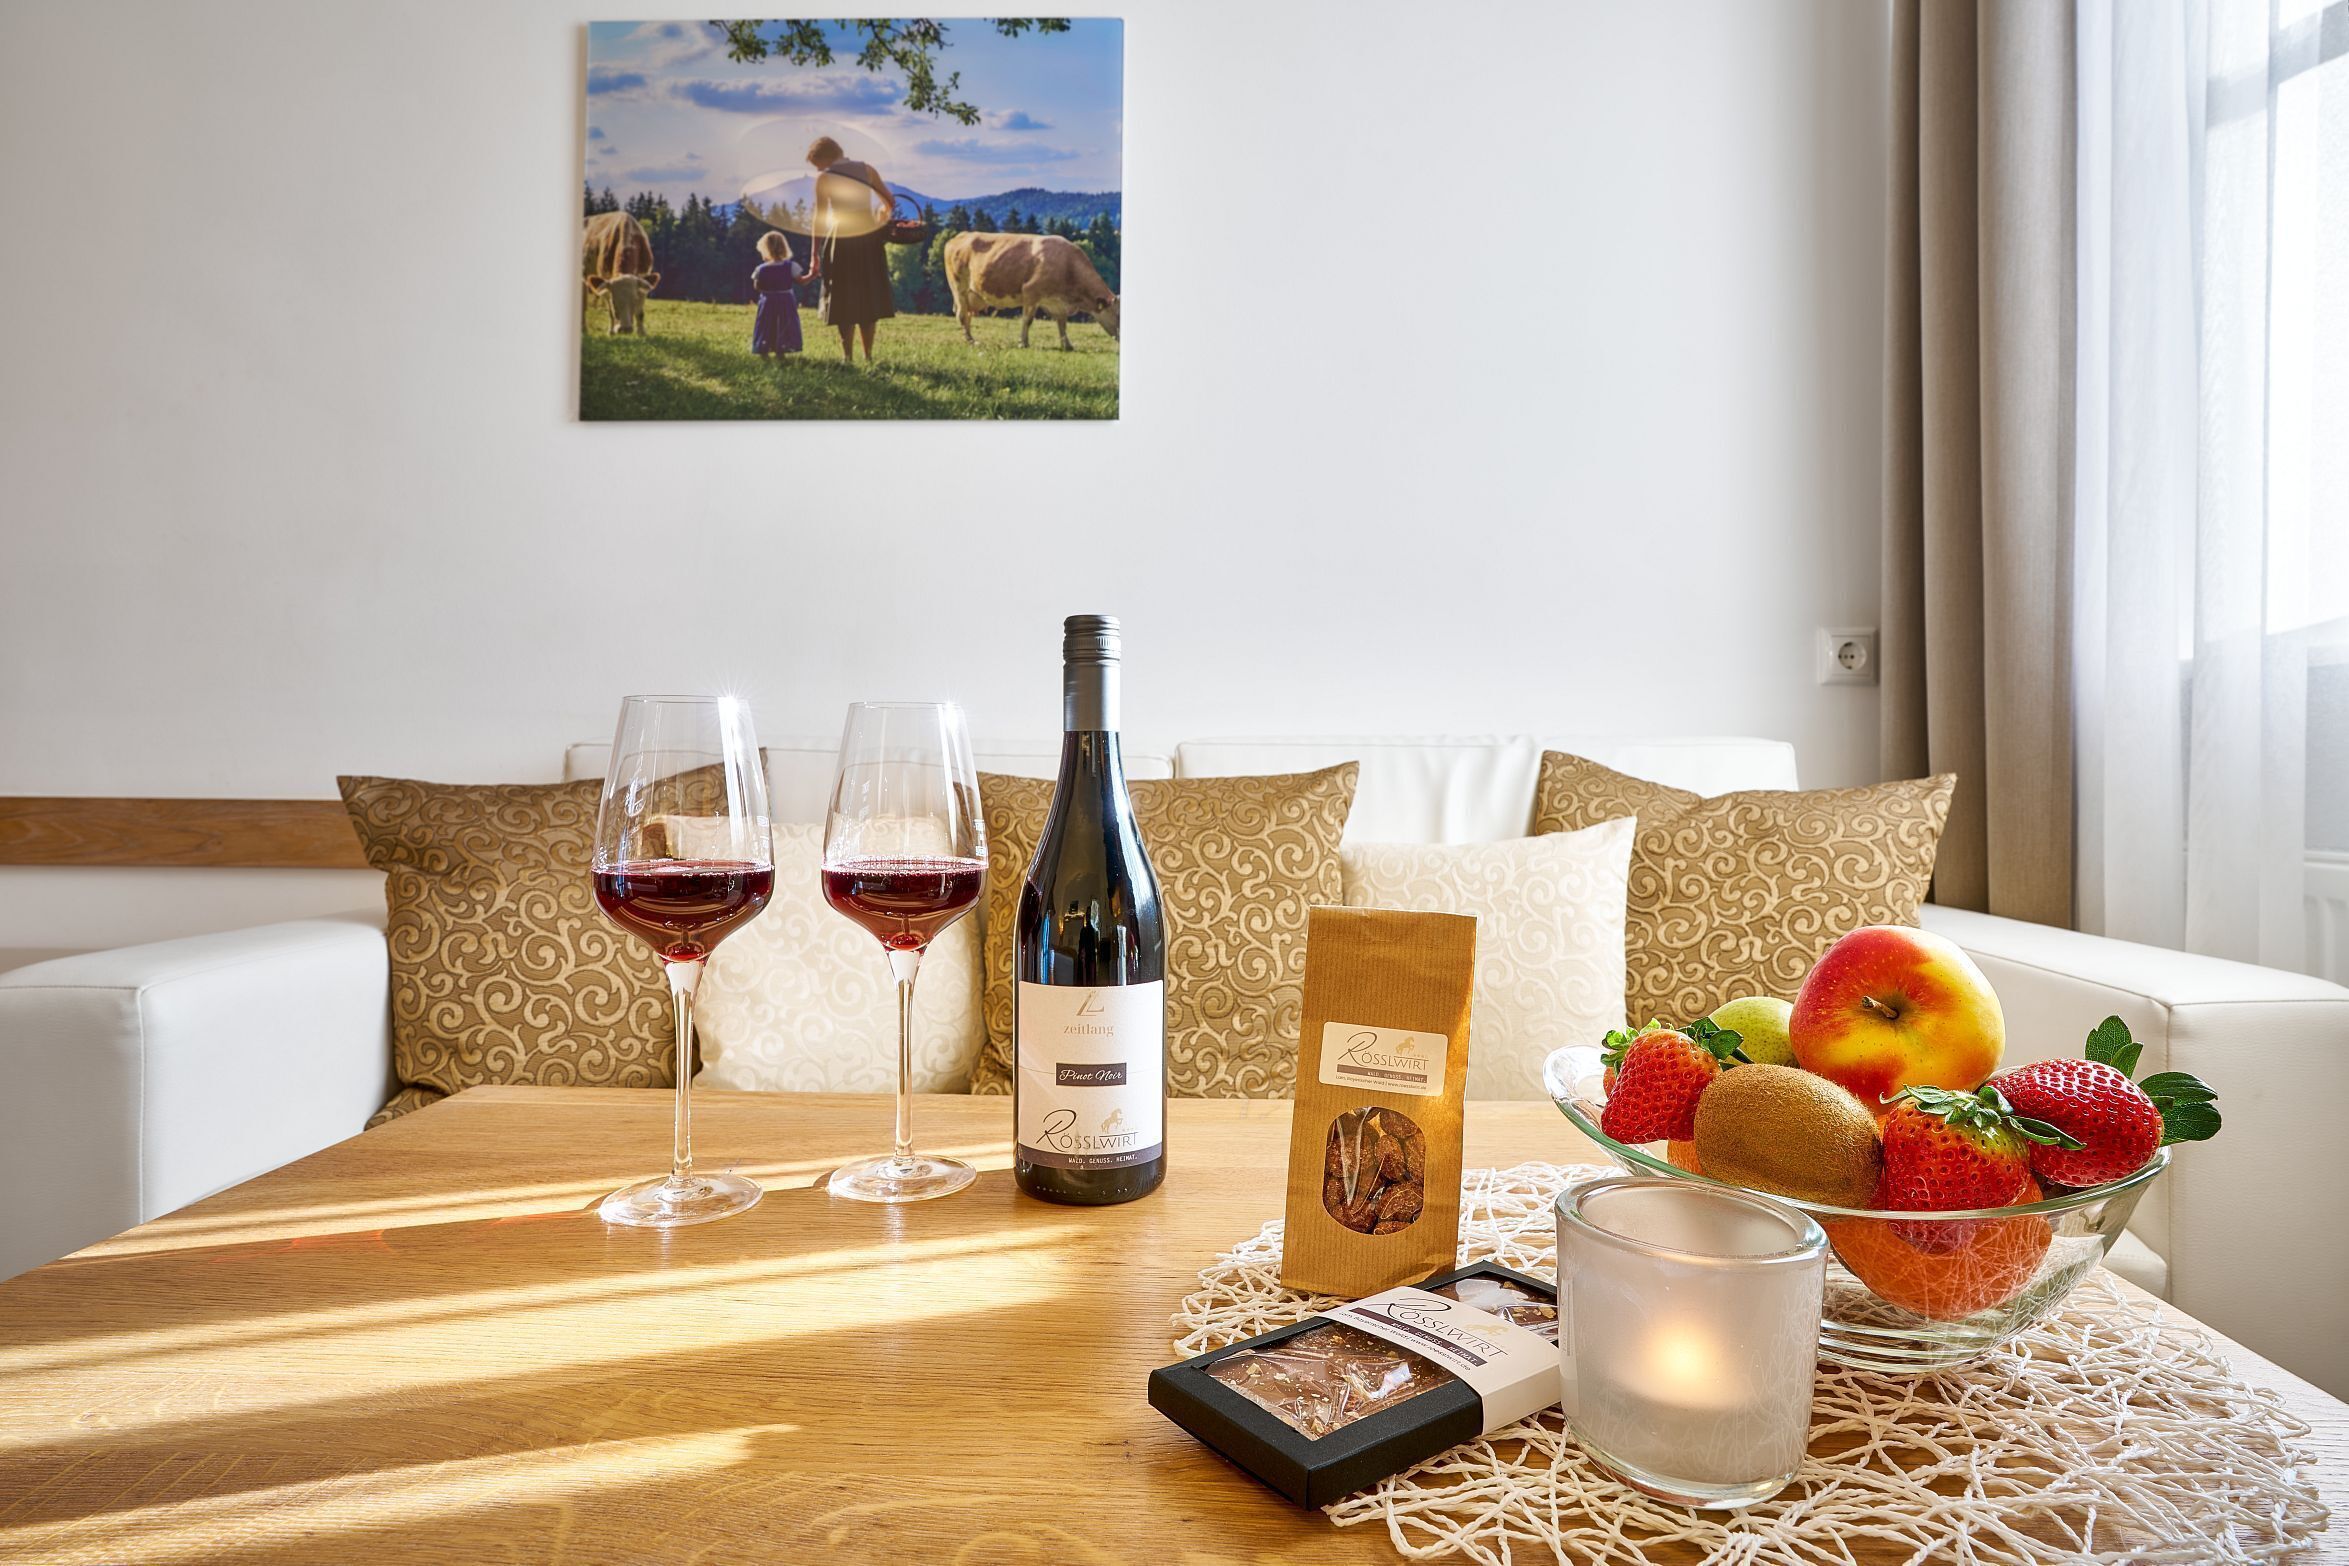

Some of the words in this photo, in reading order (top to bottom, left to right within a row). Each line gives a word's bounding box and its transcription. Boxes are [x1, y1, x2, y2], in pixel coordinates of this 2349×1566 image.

[1063, 1024, 1114, 1037] zeitlang
[1338, 1031, 1429, 1071] RÖSSLWIRT
[1059, 1069, 1093, 1081] Pinot
[1095, 1069, 1123, 1081] Noir
[1036, 1109, 1139, 1152] RÖSSLWIRT
[1365, 1297, 1508, 1358] RÖSSLWIRT
